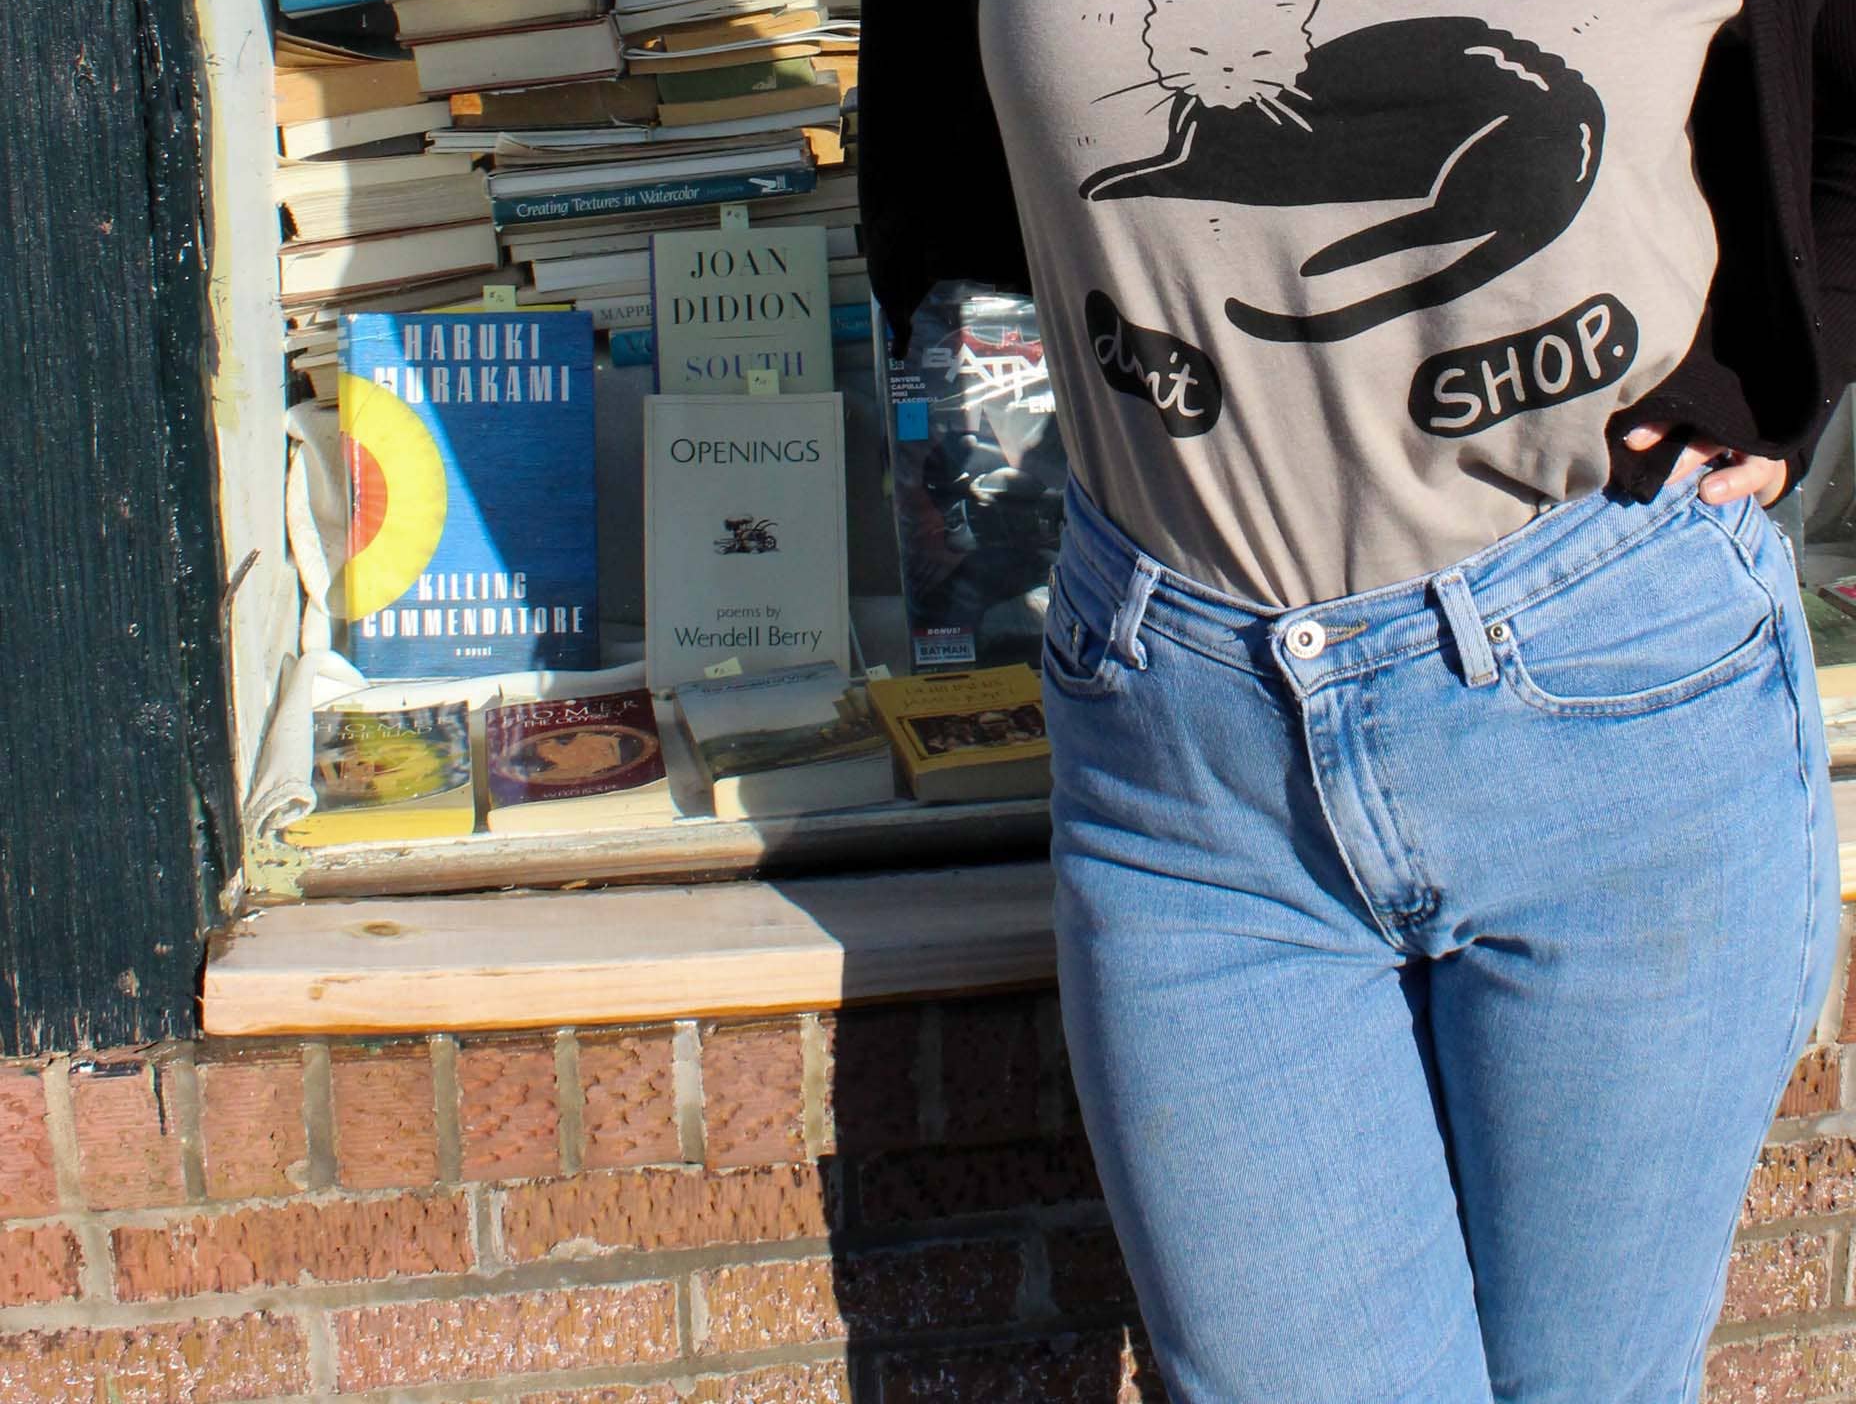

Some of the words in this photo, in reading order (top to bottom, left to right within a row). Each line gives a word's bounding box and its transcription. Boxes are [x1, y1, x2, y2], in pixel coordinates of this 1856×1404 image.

[516, 199, 569, 217] Creating
[571, 195, 621, 212] Textures
[624, 194, 636, 207] in
[640, 184, 700, 204] Watercolor
[690, 247, 790, 279] JOAN
[672, 290, 814, 325] DIDION
[403, 323, 541, 361] HARUKI
[685, 349, 805, 382] SOUTH
[1430, 303, 1626, 430] SHOP.
[373, 365, 570, 404] MURAKAMI
[670, 438, 821, 464] OPENINGS
[418, 571, 528, 602] KILLING
[361, 605, 585, 638] COMMENDATORE
[716, 605, 761, 621] poems
[766, 604, 782, 621] by
[464, 645, 493, 657] novel
[674, 626, 760, 648] Wendell
[768, 625, 823, 653] Berry
[523, 718, 547, 728] THE
